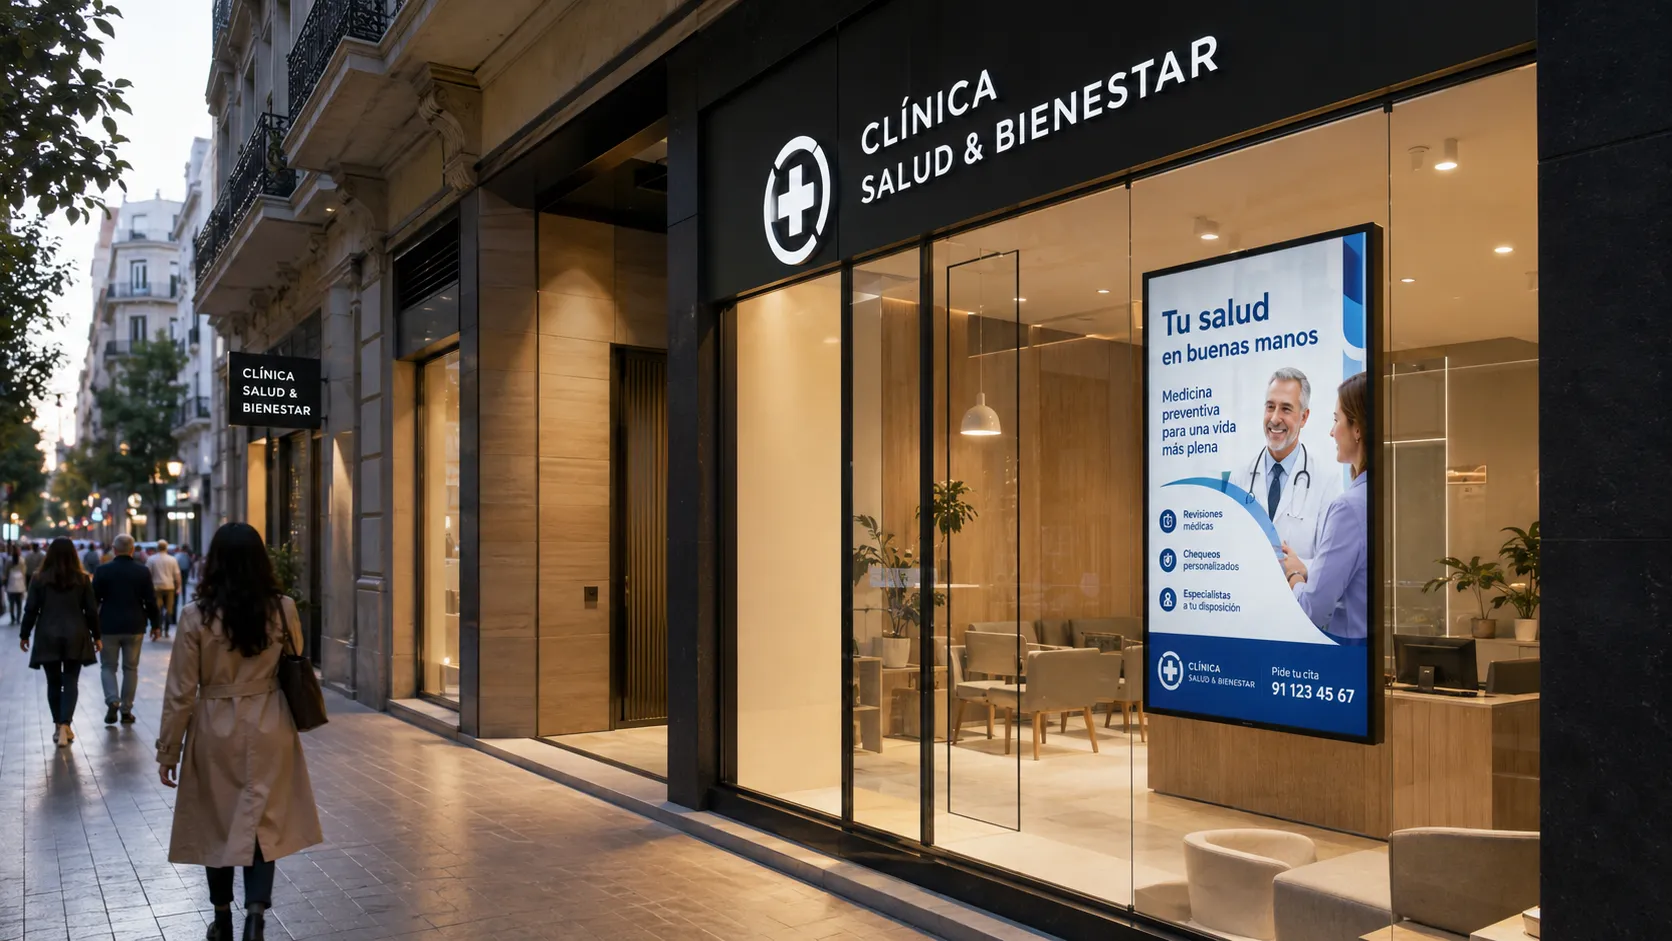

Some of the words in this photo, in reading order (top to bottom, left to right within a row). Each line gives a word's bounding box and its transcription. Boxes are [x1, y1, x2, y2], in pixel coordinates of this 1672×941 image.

[861, 69, 998, 155] CLÍNICA
[861, 144, 954, 204] SALUD
[964, 132, 983, 164] &
[996, 36, 1218, 153] BIENESTAR
[1162, 309, 1190, 336] Tu
[1199, 292, 1269, 331] salud
[1162, 350, 1181, 365] en
[1187, 339, 1249, 362] buenas
[1255, 329, 1318, 352] manos
[242, 366, 295, 382] CLÍNICA
[243, 385, 285, 397] SALUD
[289, 389, 297, 399] &
[1162, 387, 1212, 402] Medicina
[243, 402, 311, 416] BIENESTAR
[1162, 403, 1219, 423] preventiva
[1162, 425, 1186, 441] para
[1189, 424, 1209, 436] una
[1213, 420, 1236, 433] vida
[1162, 442, 1184, 456] más
[1187, 441, 1218, 457] plena
[1183, 510, 1223, 519] Revisiones
[1183, 521, 1213, 530] médicas
[1183, 550, 1220, 560] Chequeos
[1183, 562, 1239, 572] personalizados
[1184, 590, 1231, 600] Especialistas
[1189, 602, 1197, 610] tu
[1199, 602, 1240, 613] disposición
[1188, 661, 1220, 673] CLÍNICA
[1272, 667, 1290, 677] Pide
[1292, 669, 1301, 678] tu
[1303, 669, 1319, 680] cita
[1189, 674, 1209, 683] SALUD
[1218, 677, 1255, 688] BIENESTAR
[1272, 682, 1285, 696] 91
[1290, 684, 1312, 698] 123
[1316, 688, 1333, 701] 45
[1338, 689, 1354, 704] 67
